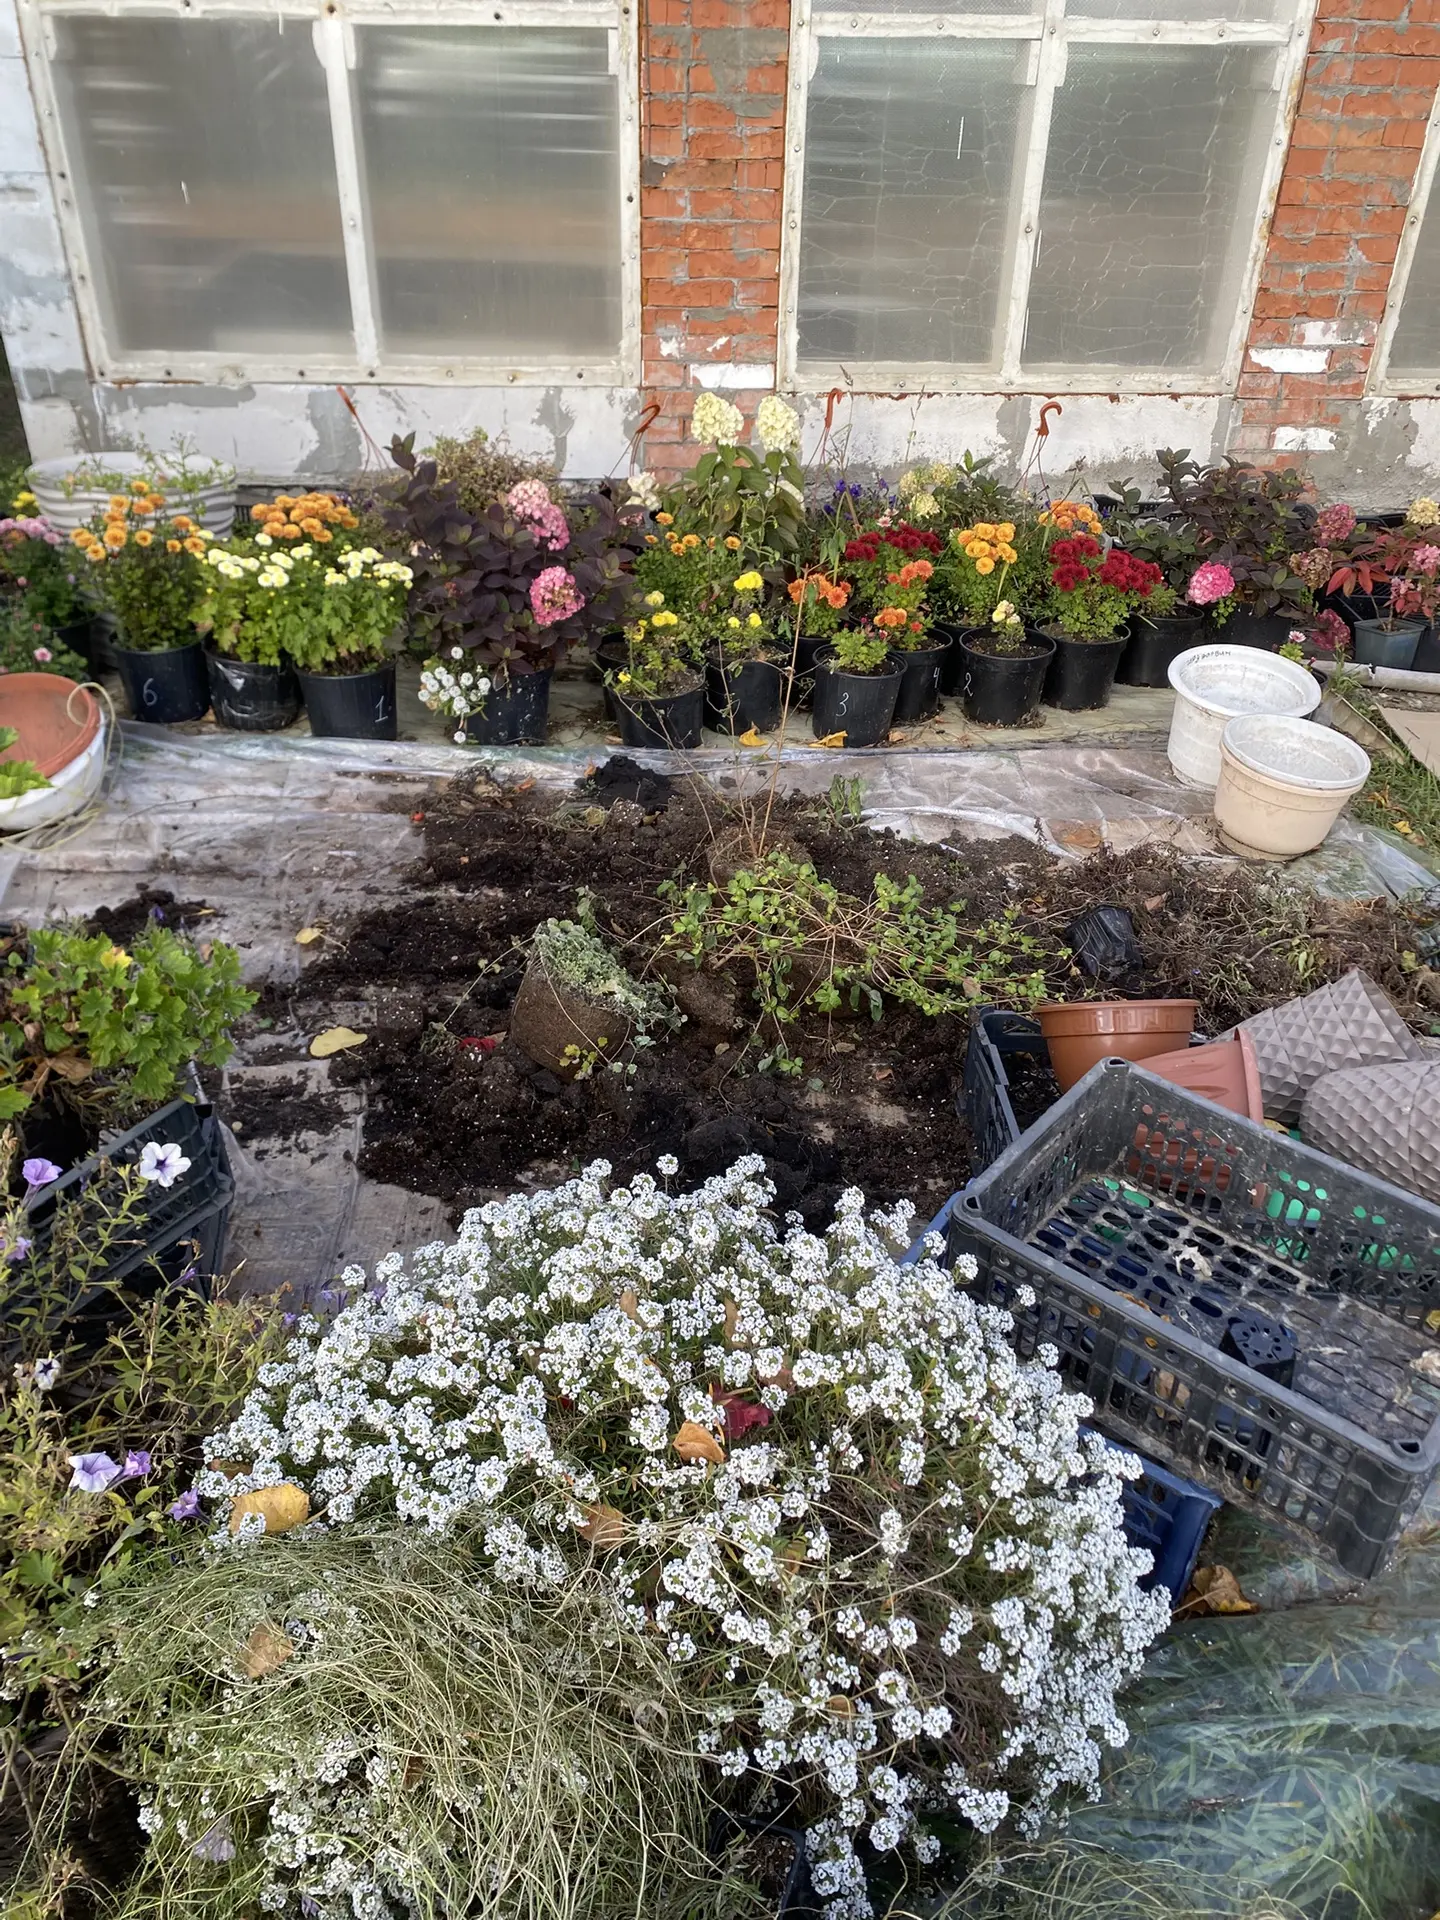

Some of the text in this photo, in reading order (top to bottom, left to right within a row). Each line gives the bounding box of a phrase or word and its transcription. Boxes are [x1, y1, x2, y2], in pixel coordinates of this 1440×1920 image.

[933, 666, 940, 689] 4
[963, 672, 974, 697] 2
[143, 678, 158, 706] 6
[835, 692, 849, 717] 3
[374, 695, 389, 723] 1
